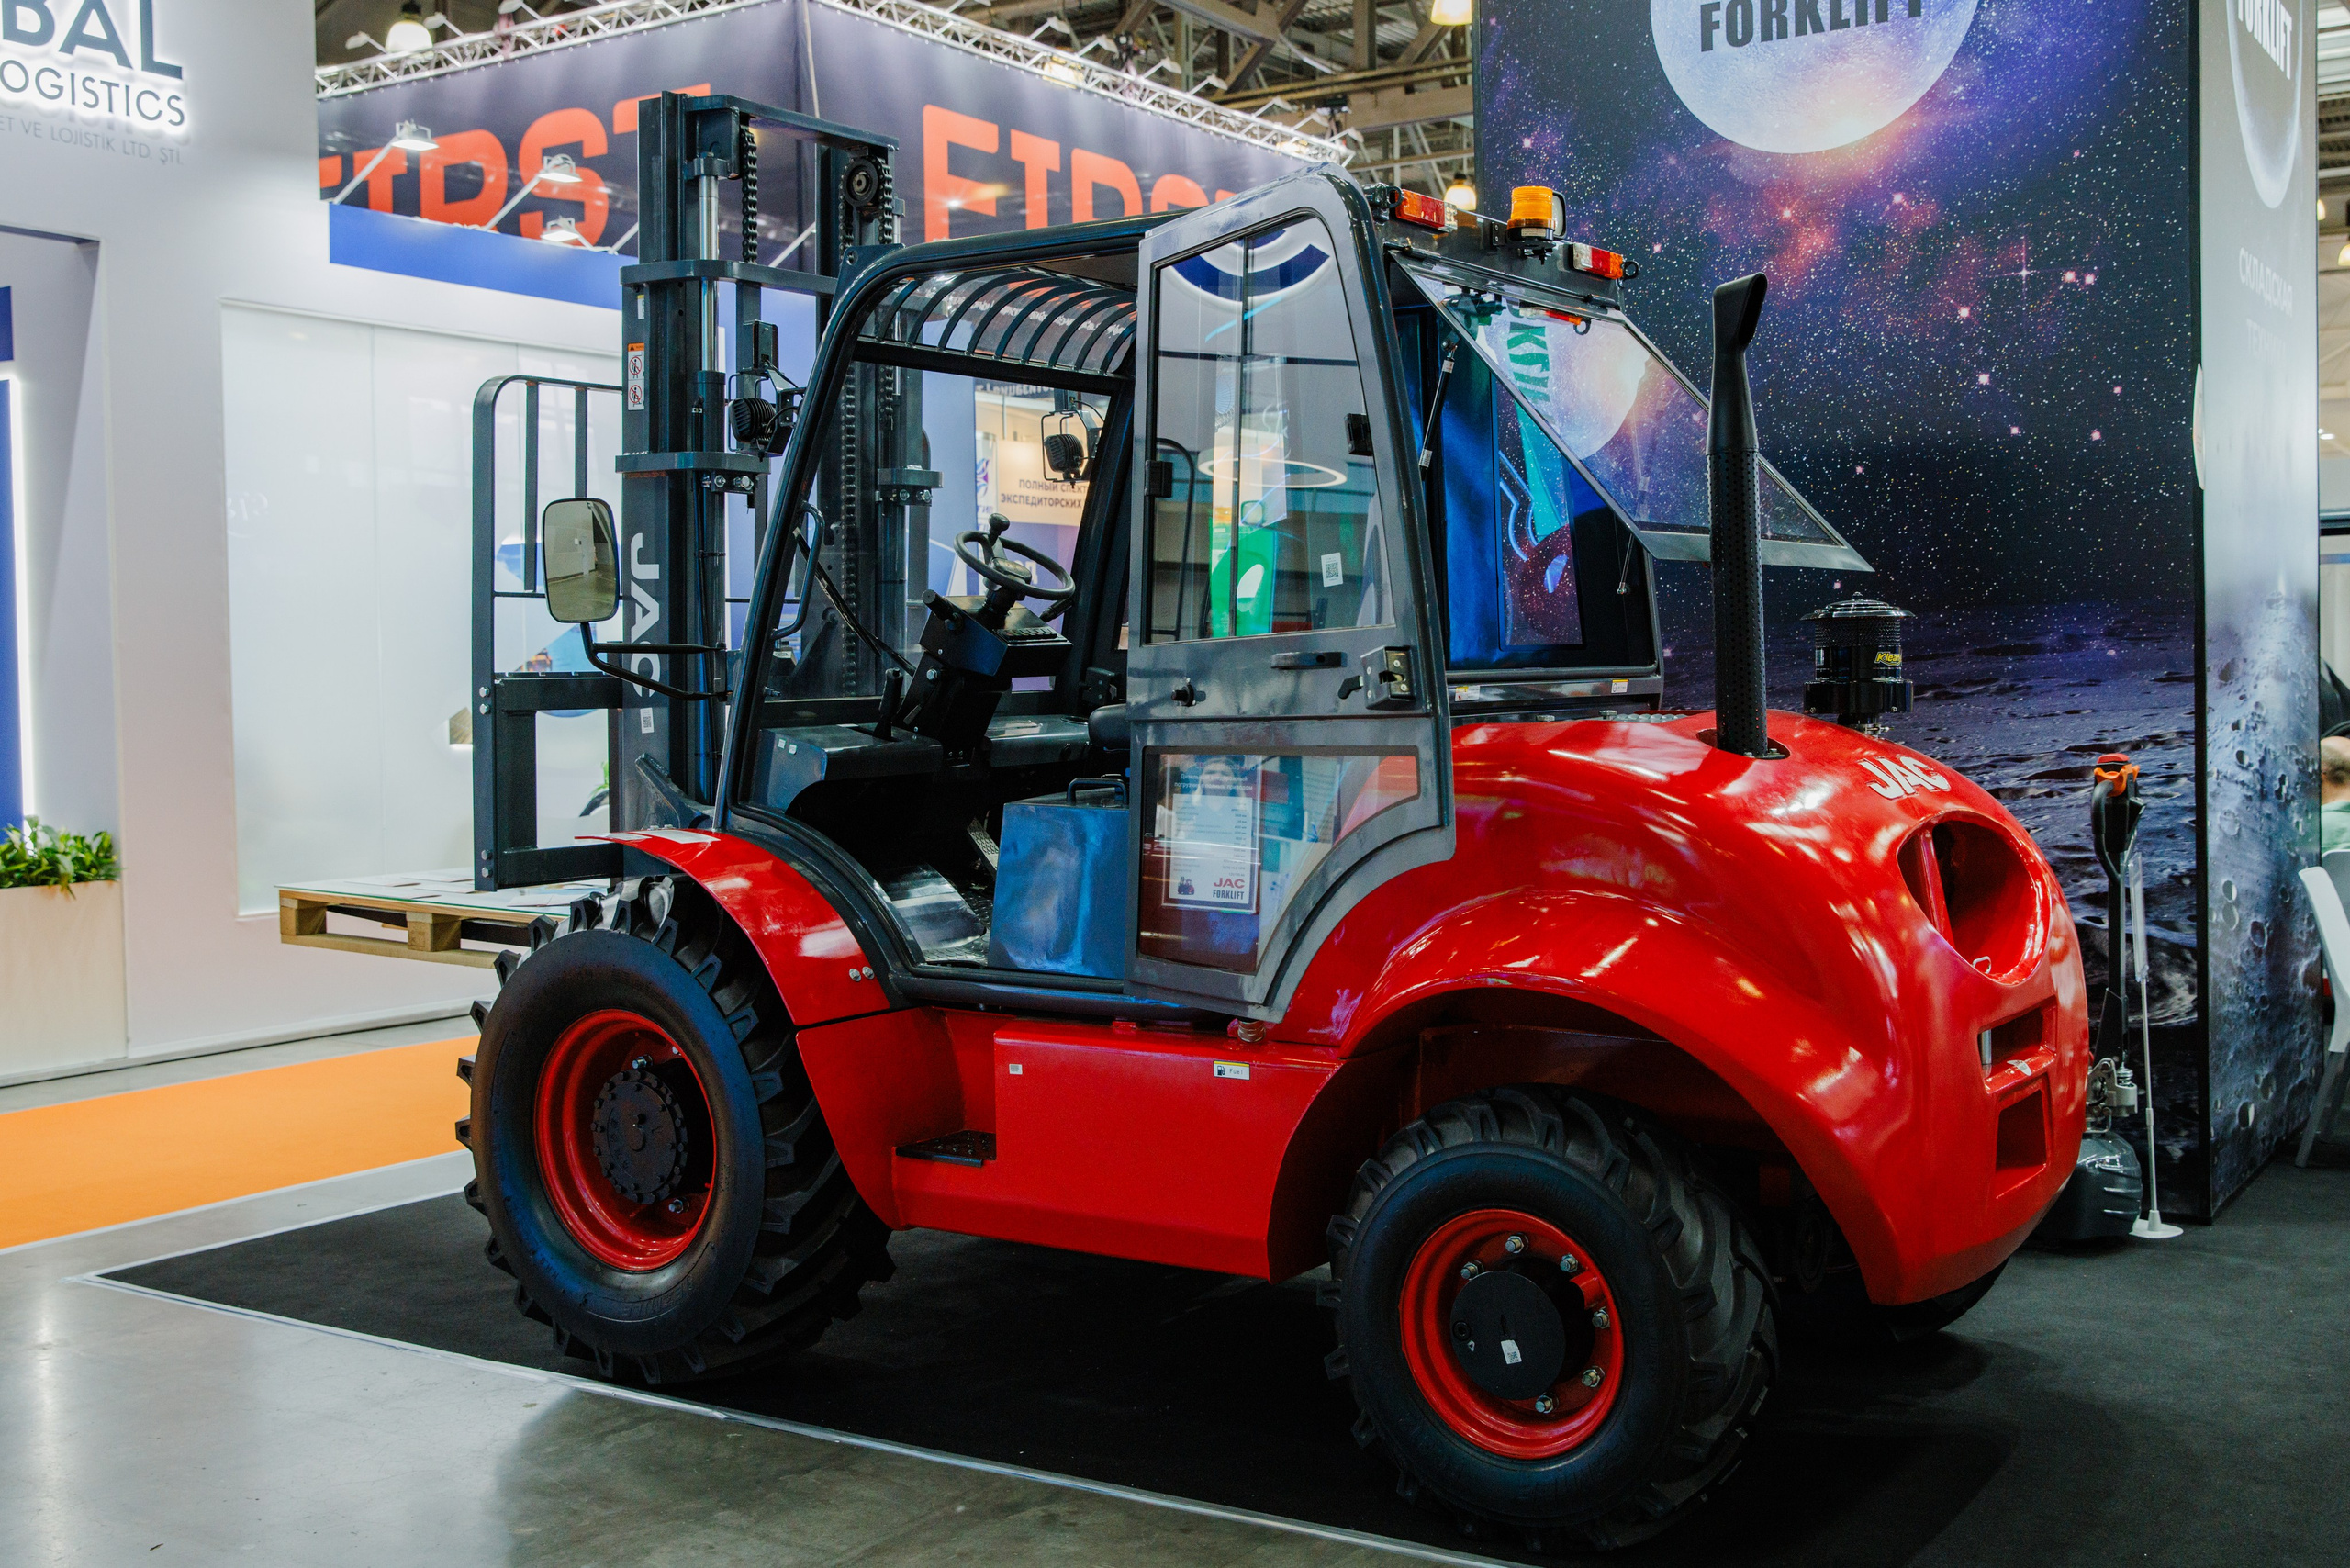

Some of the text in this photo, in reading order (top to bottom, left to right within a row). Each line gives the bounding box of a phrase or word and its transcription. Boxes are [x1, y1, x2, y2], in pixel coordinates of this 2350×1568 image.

[0, 60, 185, 127] OGISTICS
[21, 119, 42, 139] VE
[2239, 246, 2293, 318] СКЛАДСКАЯ
[1019, 479, 1058, 492] ПОЛНЫЙ
[1001, 493, 1082, 509] ЭКСПЕДИТОРСКИХ
[631, 532, 660, 697] JAC
[1858, 756, 1950, 799] JAC
[1214, 877, 1246, 889] JAC
[1213, 889, 1245, 900] FORKLIFT
